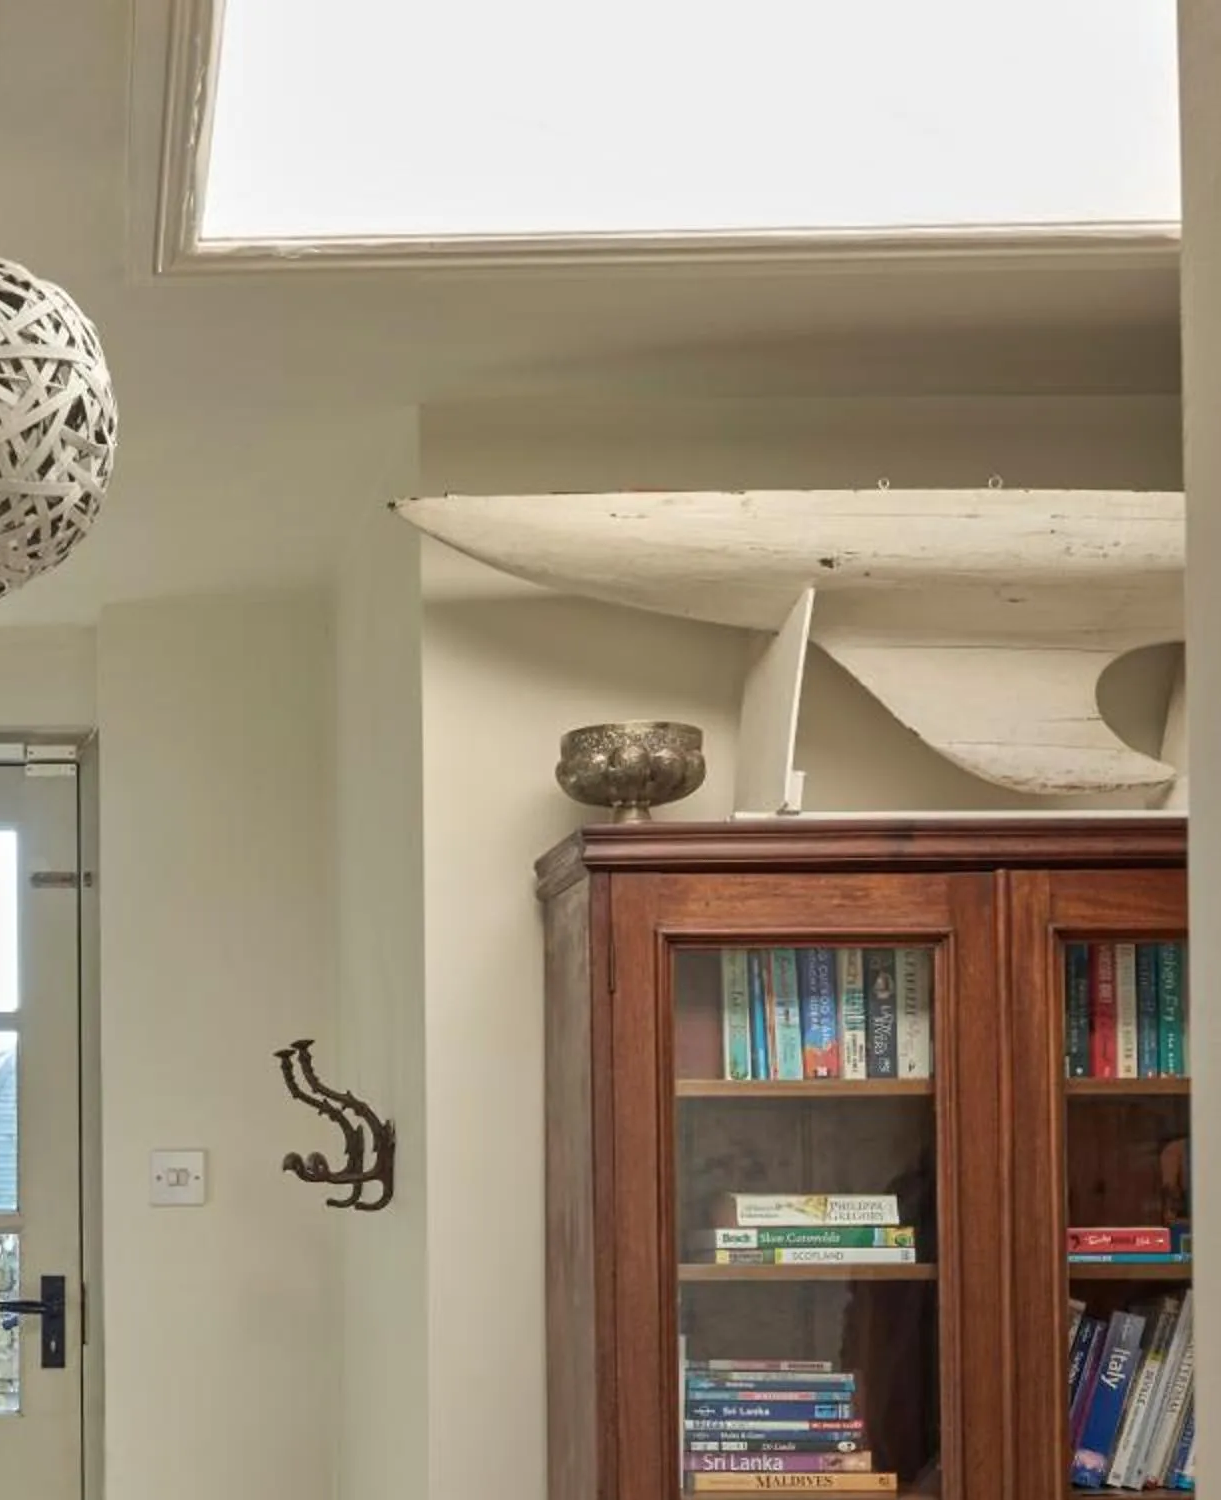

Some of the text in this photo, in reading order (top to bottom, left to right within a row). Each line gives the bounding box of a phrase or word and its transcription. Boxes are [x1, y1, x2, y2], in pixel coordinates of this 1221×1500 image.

[829, 1201, 884, 1211] PHILIPPA
[828, 1211, 884, 1221] GREGORY
[791, 1251, 844, 1261] SCOTLAND
[1100, 1346, 1130, 1391] Italy
[721, 1406, 770, 1416] Sri Lanka
[701, 1454, 784, 1471] Sri Lanka
[755, 1475, 833, 1489] MALDIVES
